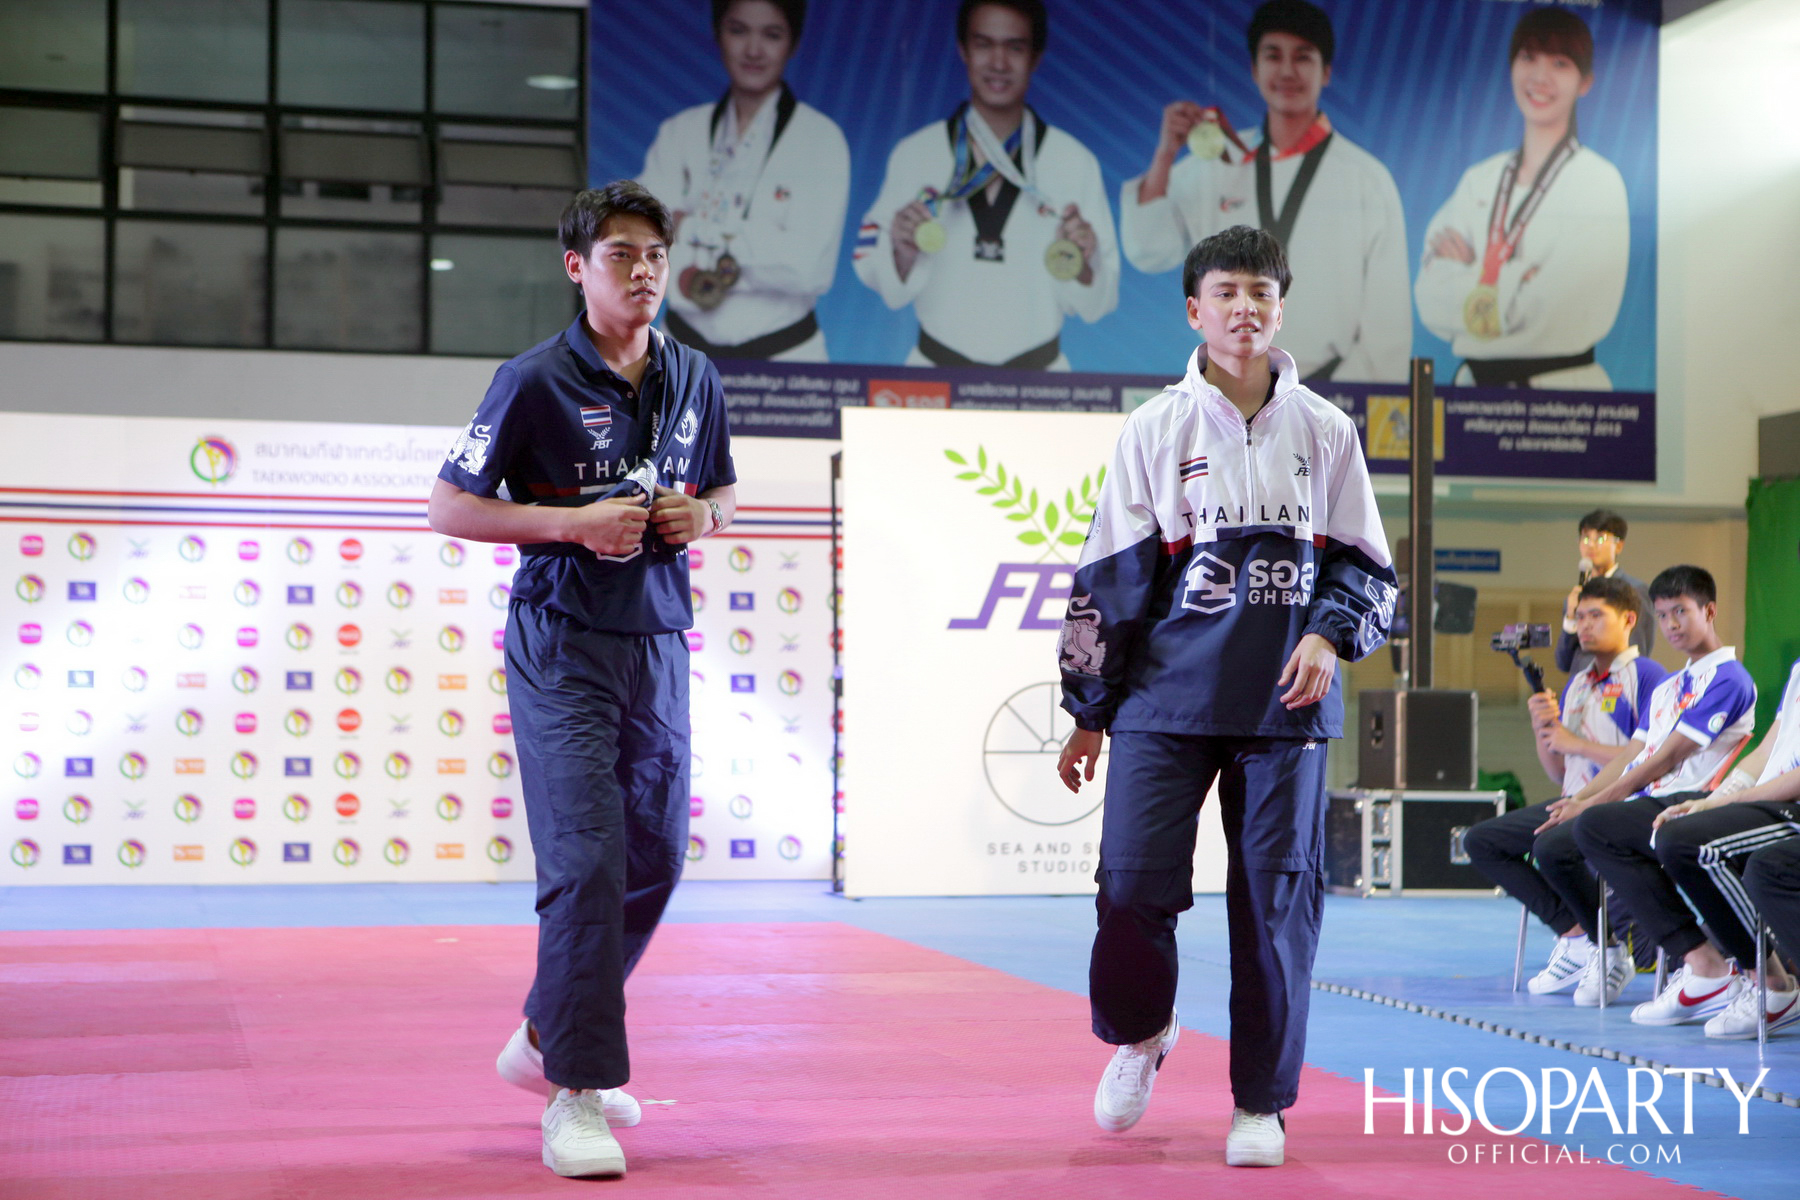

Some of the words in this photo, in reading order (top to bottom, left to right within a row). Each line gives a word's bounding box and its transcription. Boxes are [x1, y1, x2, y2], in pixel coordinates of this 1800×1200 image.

[590, 439, 613, 450] FBT
[252, 469, 348, 486] TAEKWONDO
[352, 472, 436, 488] ASSOCIATIO
[1294, 466, 1311, 476] FB
[1182, 505, 1309, 527] THAILAN
[947, 562, 1077, 630] FB
[1281, 590, 1311, 607] BAN
[987, 842, 1024, 855] SEA
[1034, 842, 1071, 855] AND
[1018, 860, 1091, 873] STUDIO
